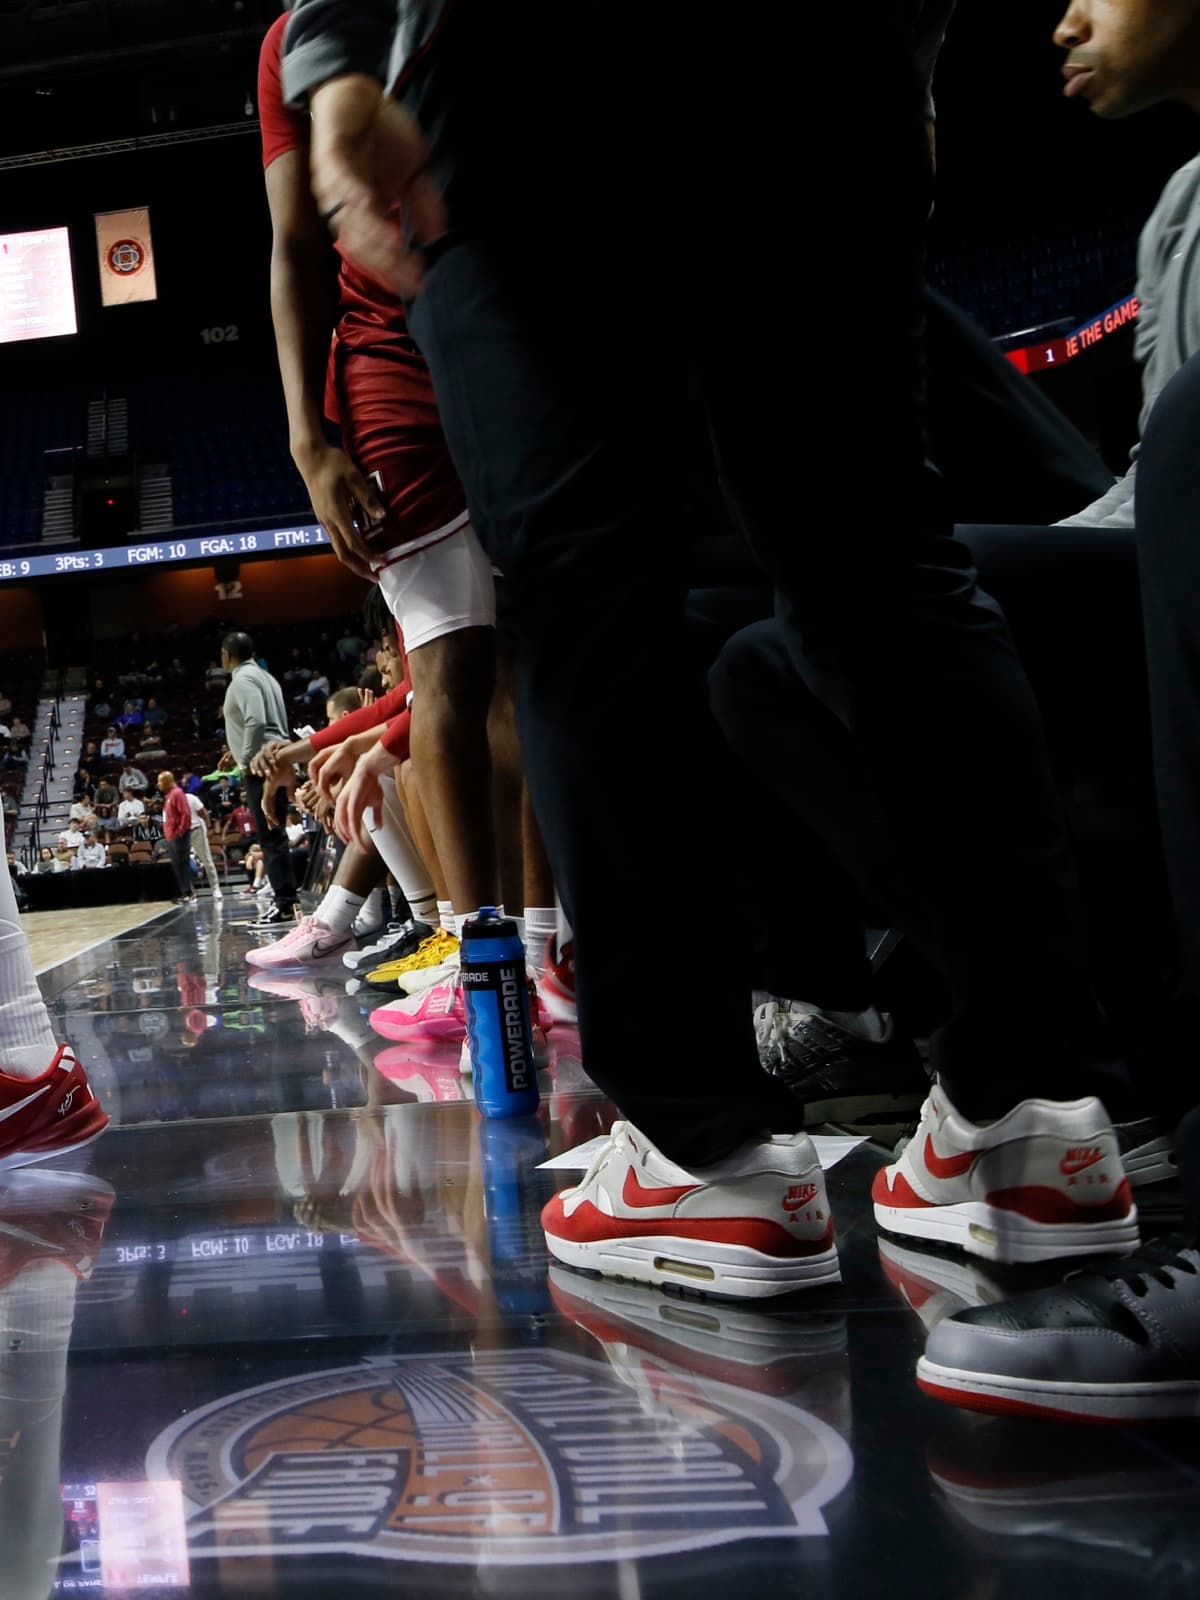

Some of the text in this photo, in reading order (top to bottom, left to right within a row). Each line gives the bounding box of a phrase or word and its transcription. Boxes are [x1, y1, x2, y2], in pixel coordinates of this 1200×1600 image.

[200, 325, 240, 345] 102
[1079, 320, 1103, 349] THE
[1103, 296, 1139, 334] GAME
[1045, 348, 1055, 362] 1
[20, 561, 30, 575] 9
[55, 555, 90, 571] 3Pts:
[94, 553, 104, 567] 3
[127, 548, 164, 563] FGM:
[168, 544, 186, 558] 10
[200, 538, 234, 554] FGA:
[239, 536, 257, 550] 18
[274, 531, 310, 546] FTM:
[214, 581, 243, 600] 12
[501, 967, 529, 1090] POWERADE
[788, 1183, 817, 1200] NIKE
[789, 1210, 824, 1223] AIR
[417, 1419, 542, 1477] HALL
[460, 1362, 769, 1524] BASKETBALL
[187, 1453, 399, 1536] FAME
[399, 1487, 548, 1528] OF
